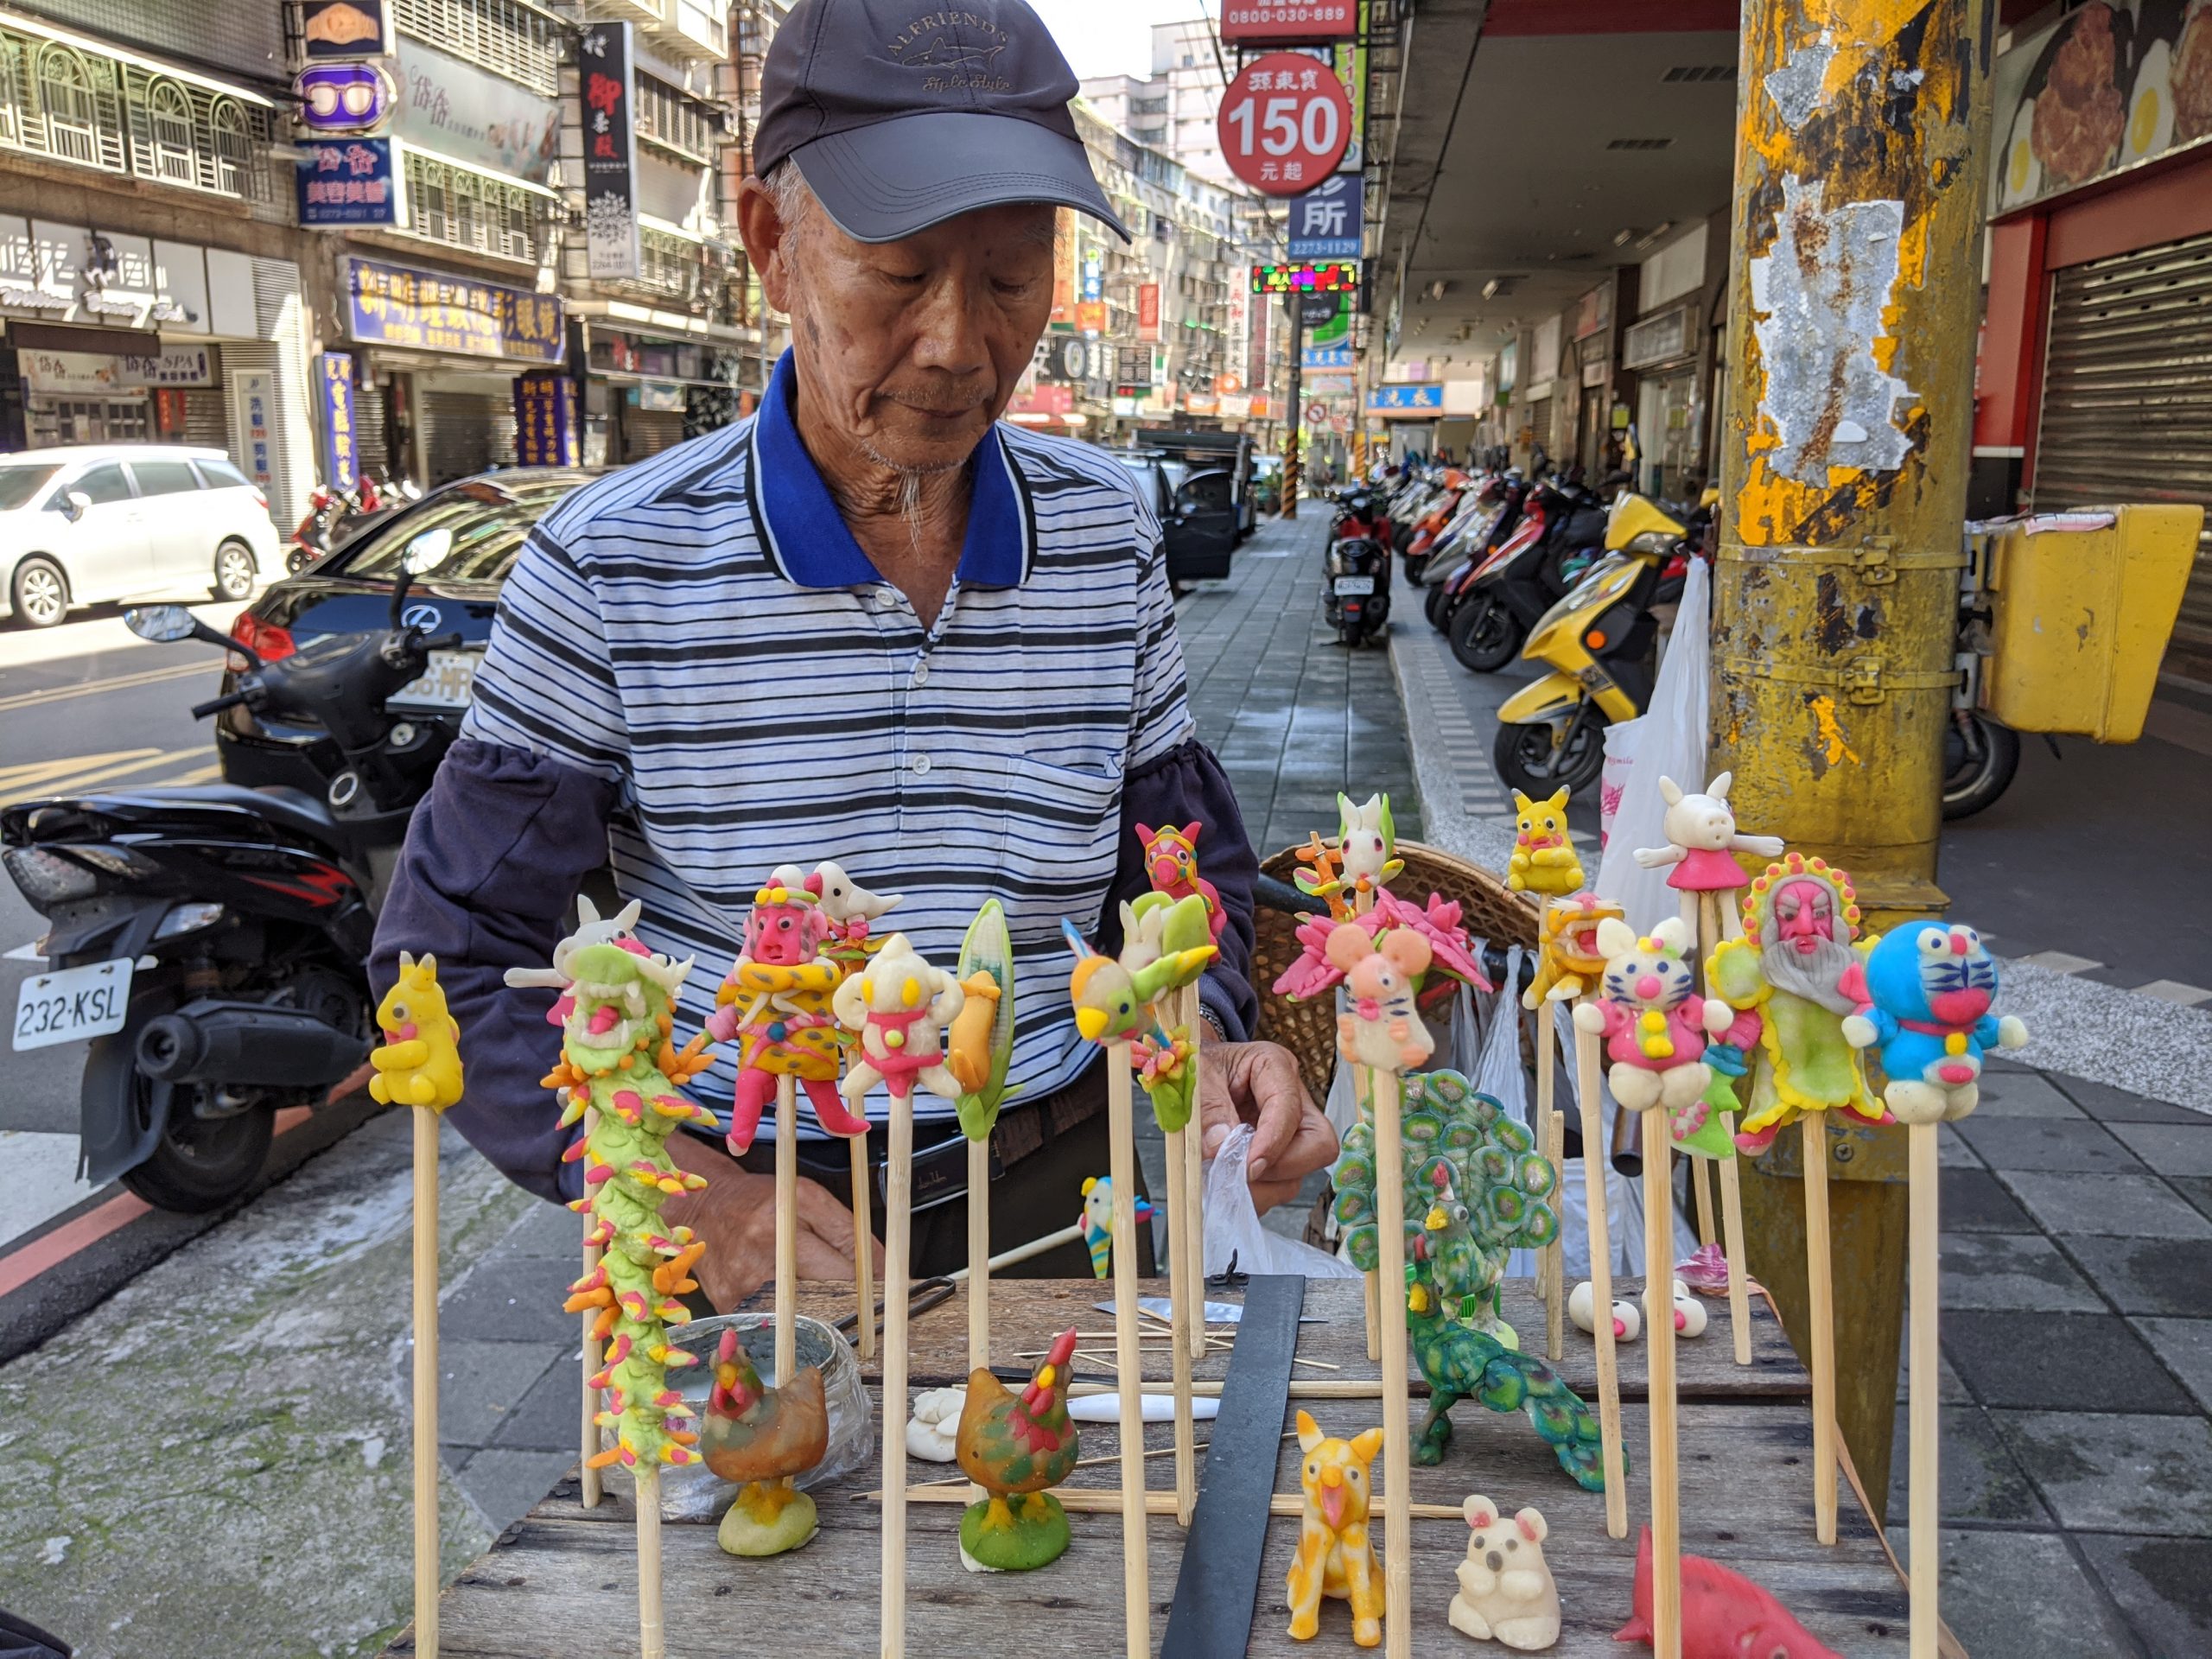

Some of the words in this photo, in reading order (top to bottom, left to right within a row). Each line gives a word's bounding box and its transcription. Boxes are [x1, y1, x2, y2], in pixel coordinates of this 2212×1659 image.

[1229, 7, 1345, 24] 0800-030-889
[1229, 96, 1338, 156] 150
[1261, 162, 1303, 181] 元起
[163, 355, 194, 370] SPA
[17, 986, 120, 1038] 232-KSL
